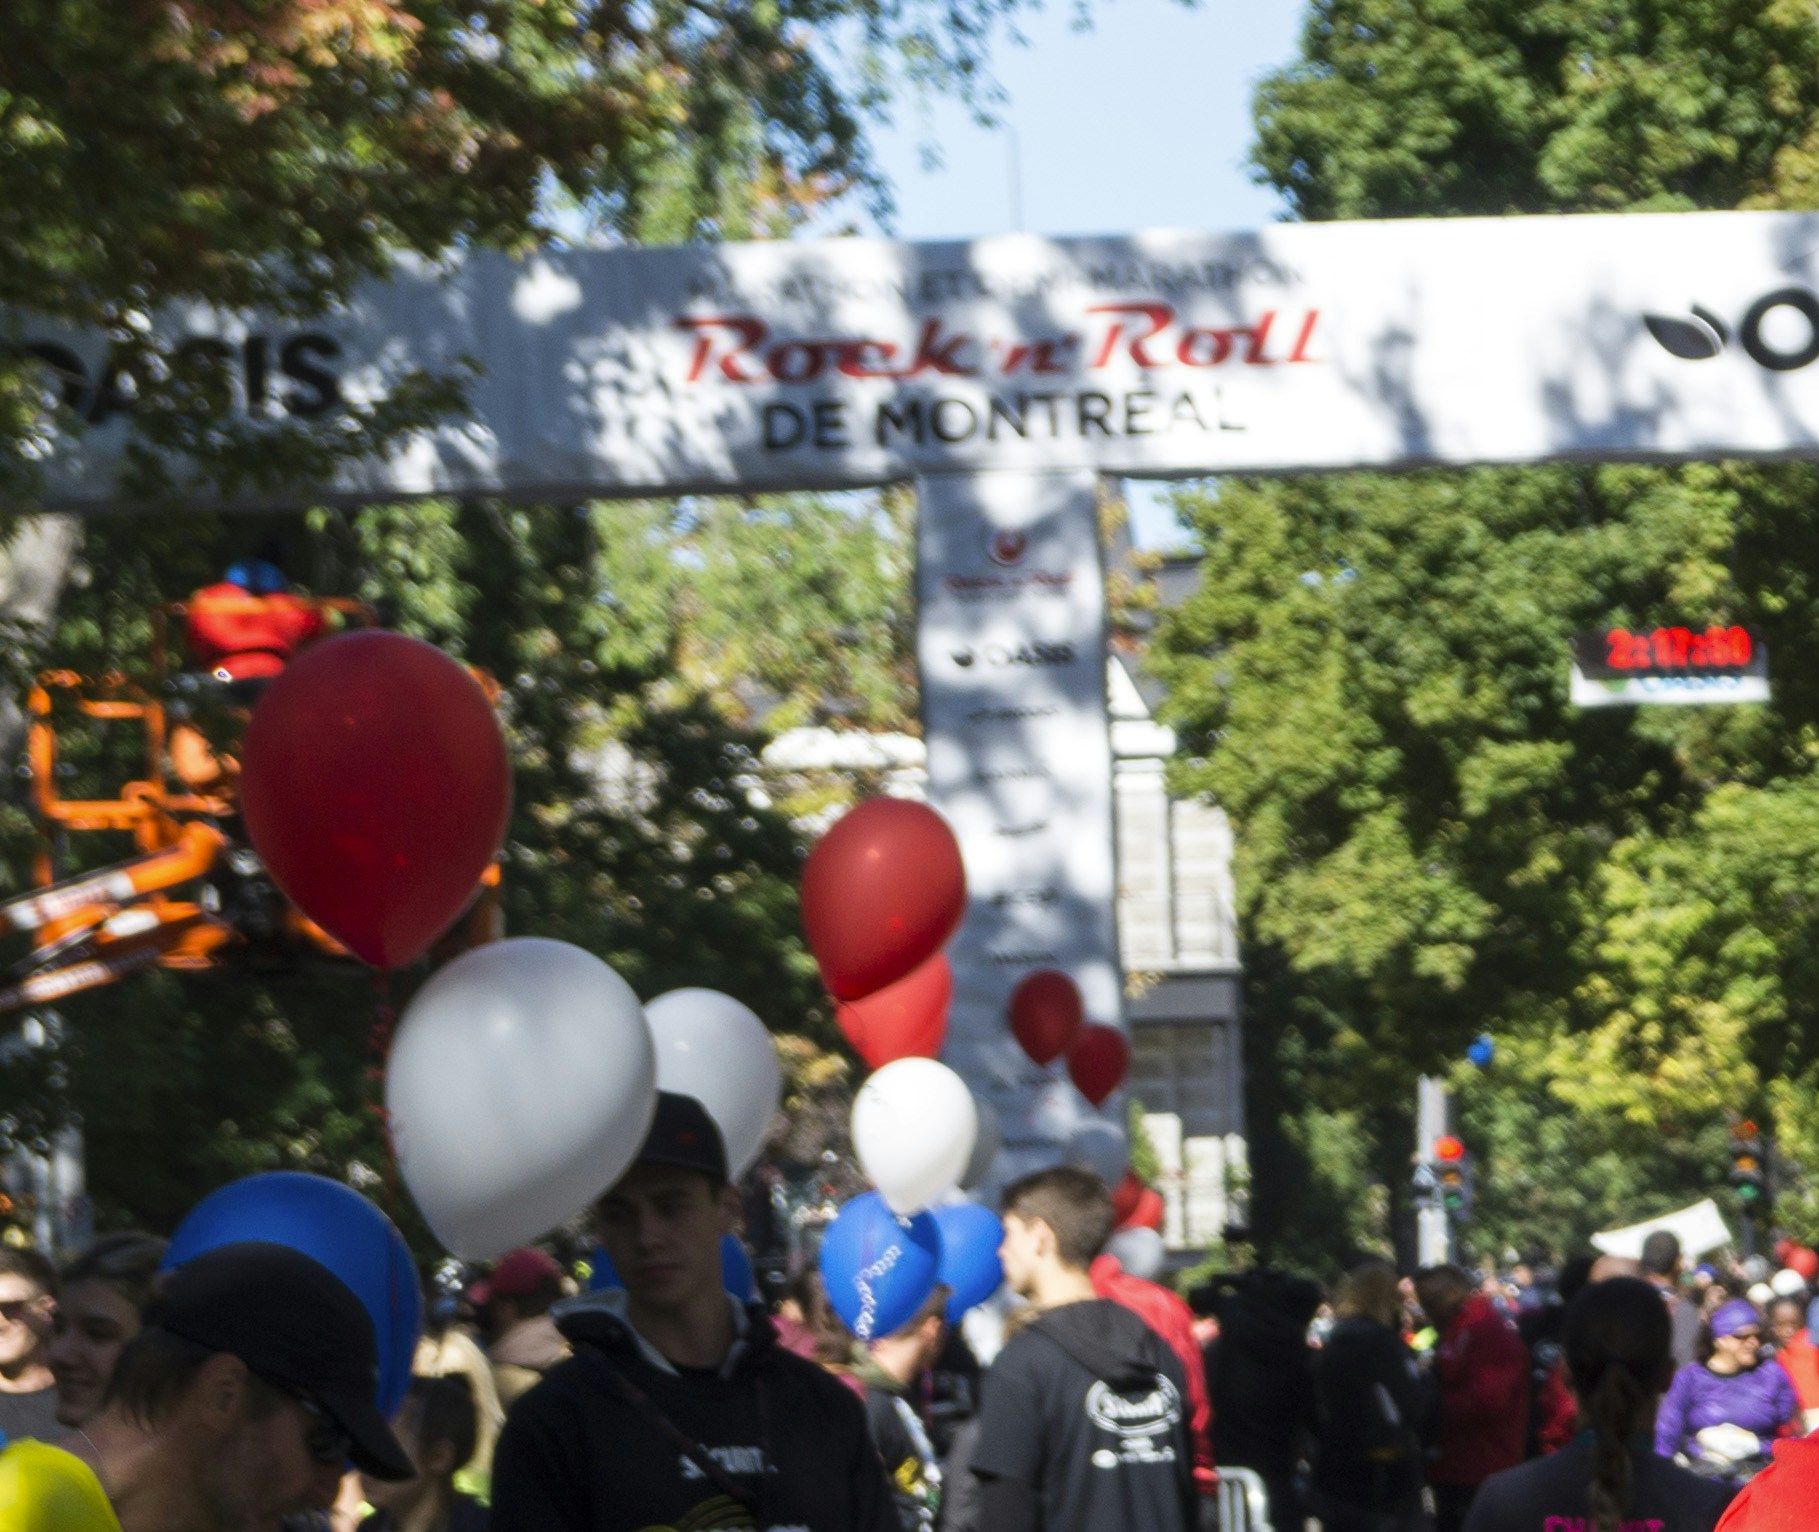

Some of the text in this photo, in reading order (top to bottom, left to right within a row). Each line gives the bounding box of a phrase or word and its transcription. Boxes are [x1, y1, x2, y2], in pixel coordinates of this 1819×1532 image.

[672, 314, 981, 384] Rock
[1086, 300, 1322, 369] Roll
[761, 375, 1247, 452] DE MONTRÉAL
